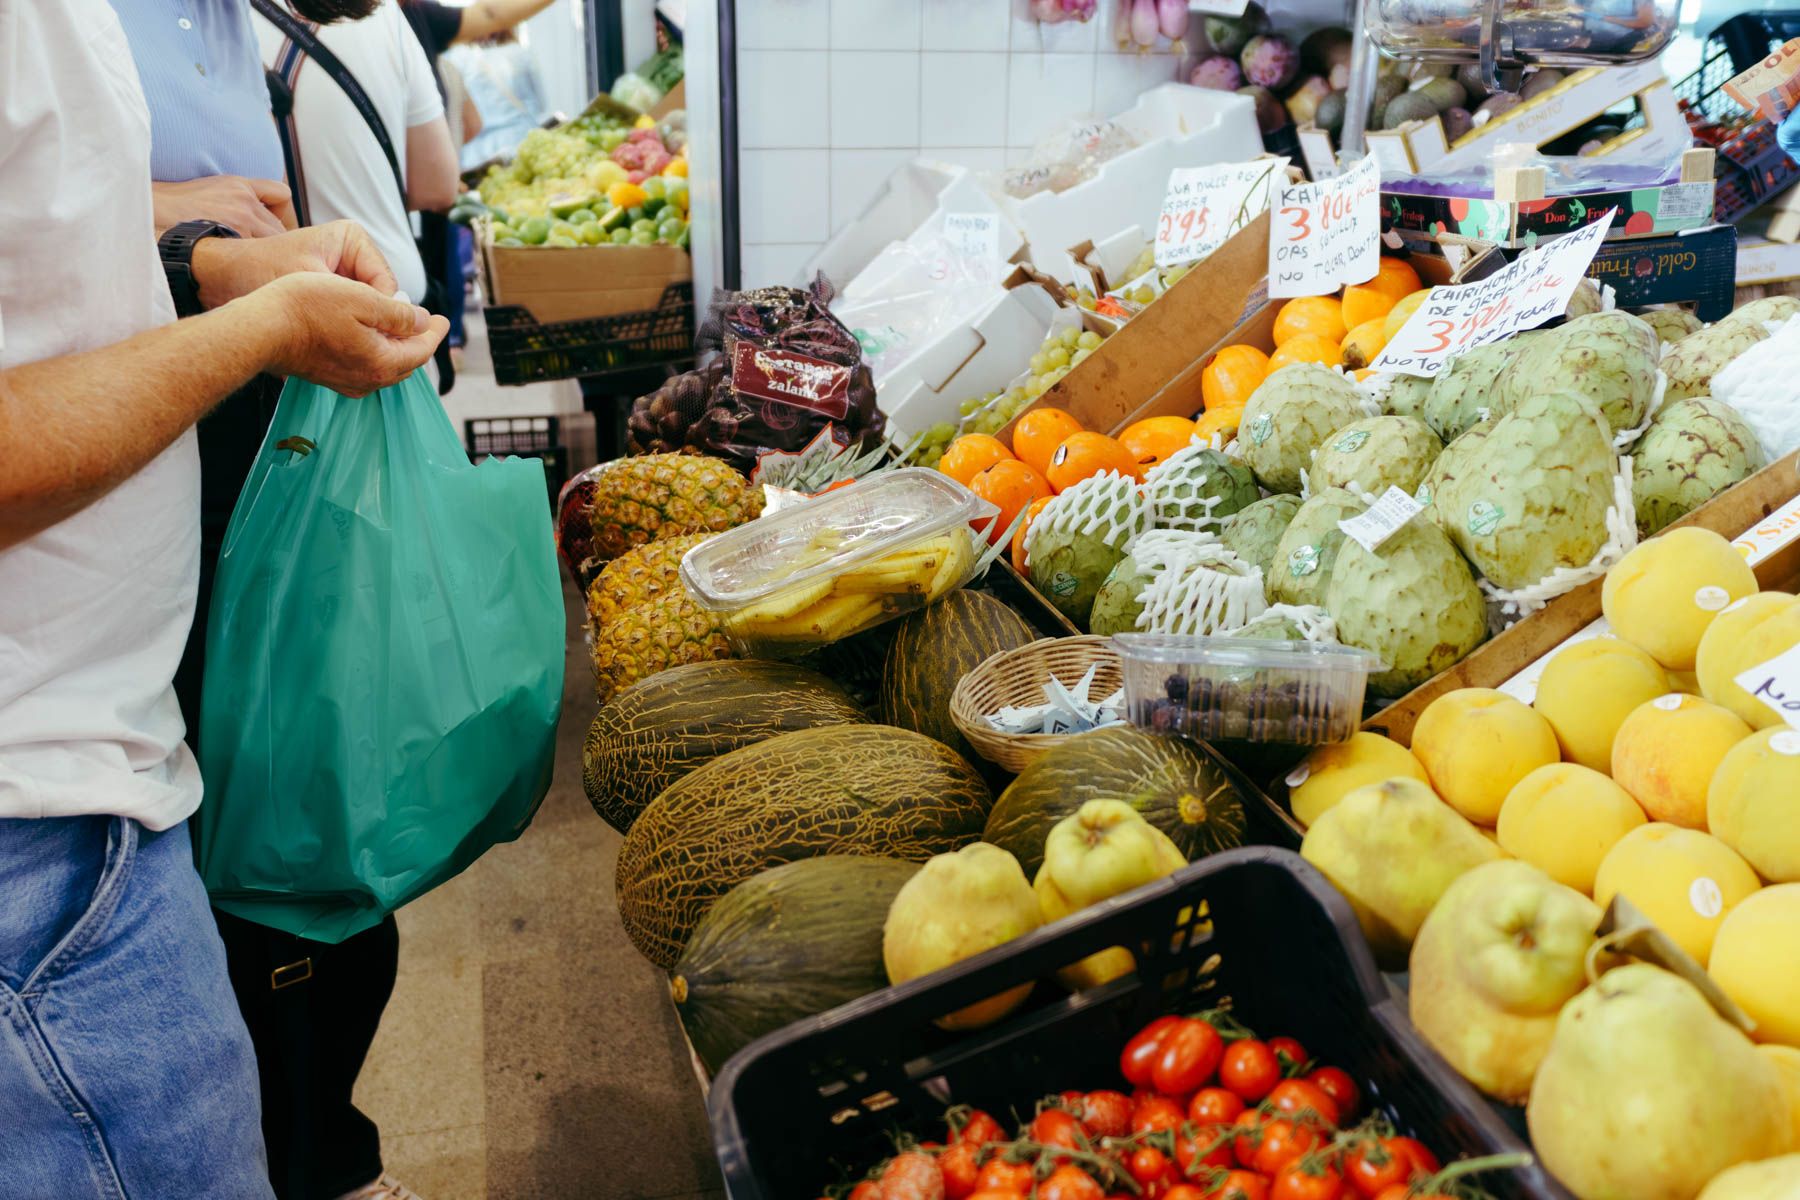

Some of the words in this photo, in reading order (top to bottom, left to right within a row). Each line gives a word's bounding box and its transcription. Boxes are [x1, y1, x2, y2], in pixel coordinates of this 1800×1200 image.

[1545, 212, 1566, 224] Don
[1657, 252, 1697, 276] Gold
[1279, 272, 1304, 285] NO
[1428, 304, 1457, 316] DE
